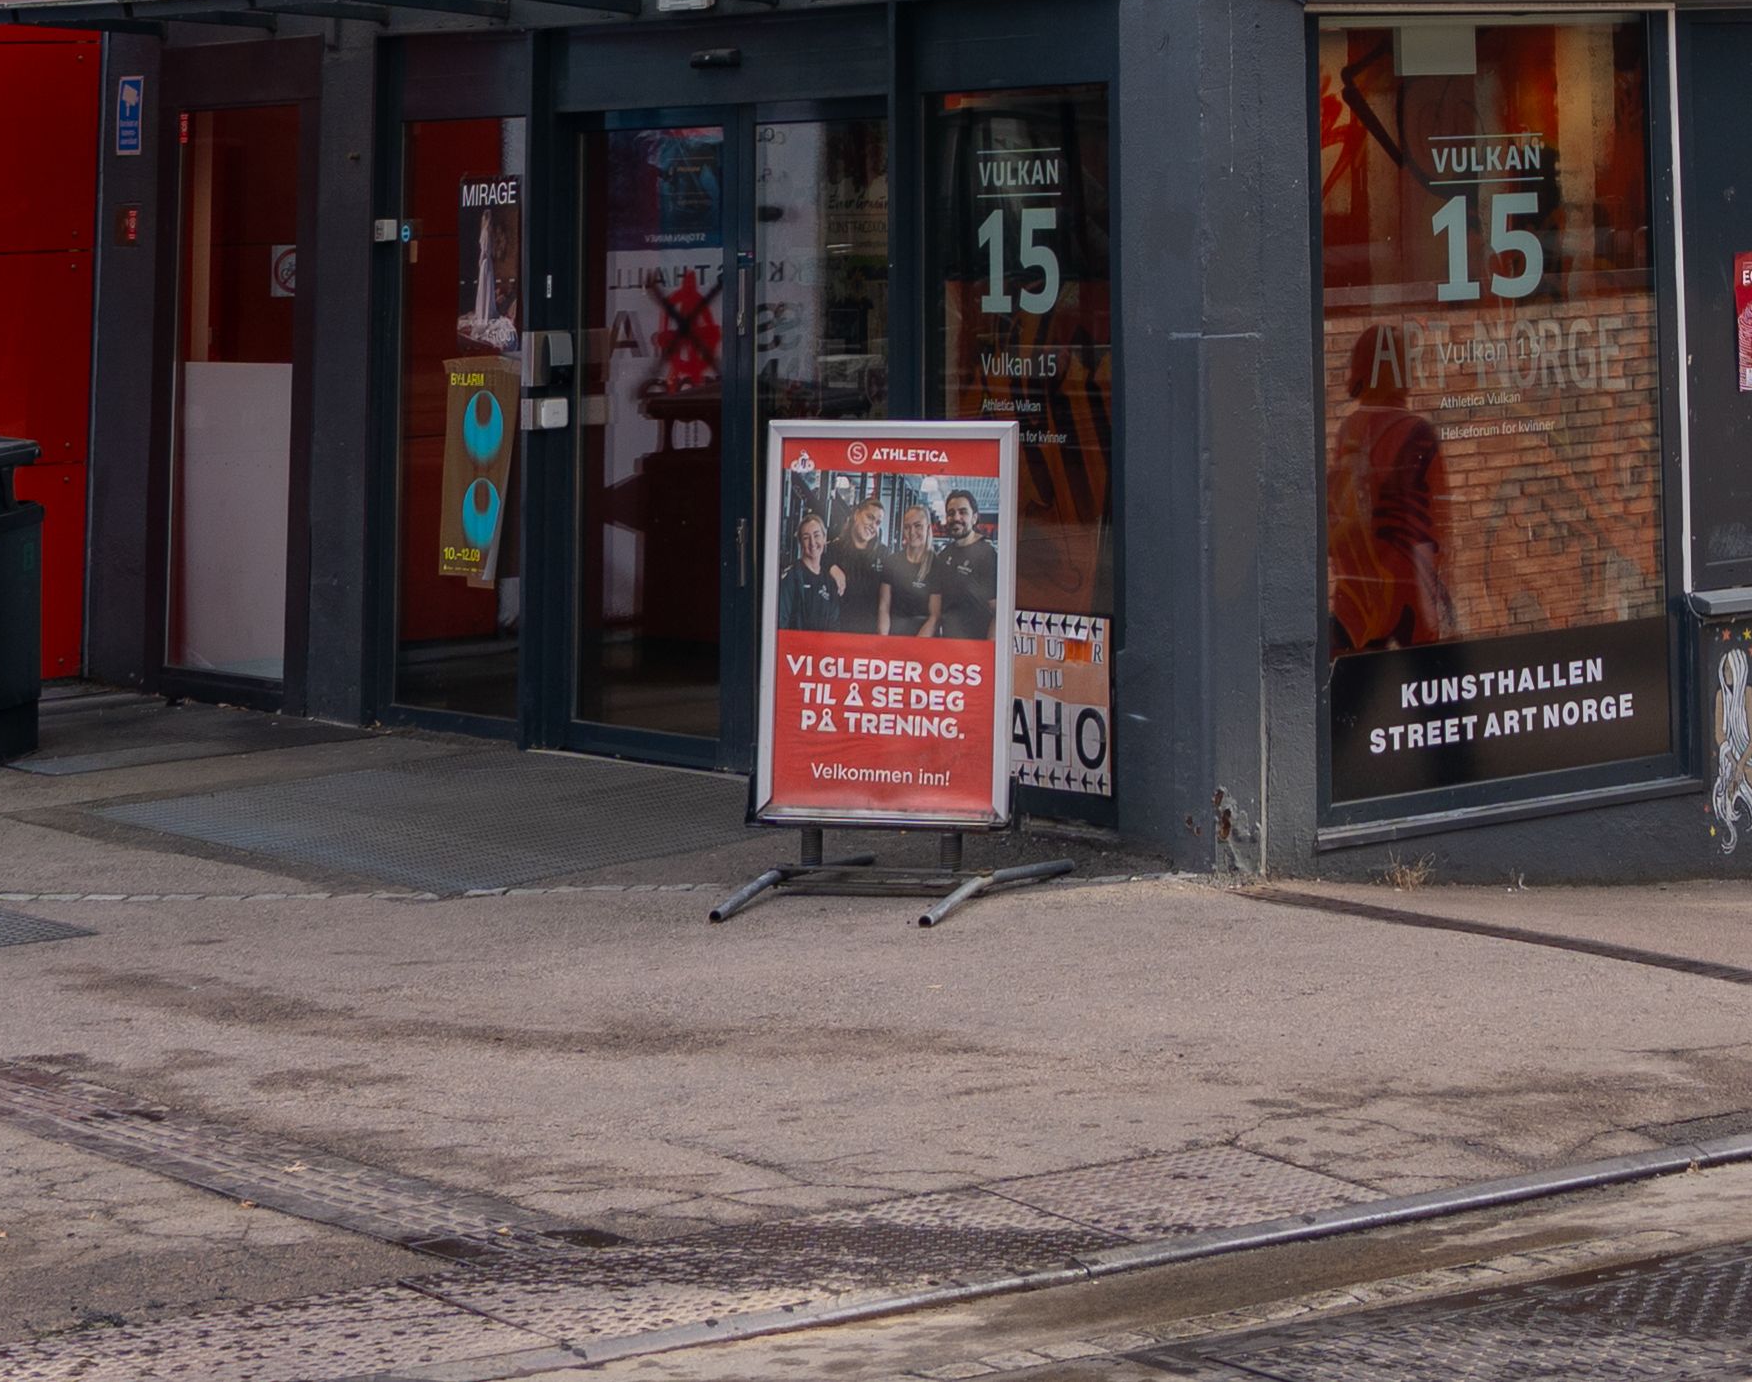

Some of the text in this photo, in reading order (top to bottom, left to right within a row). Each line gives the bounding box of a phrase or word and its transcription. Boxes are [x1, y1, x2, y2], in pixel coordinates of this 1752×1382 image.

[979, 158, 1060, 187] VULKAN
[1430, 143, 1543, 173] VULKAN
[462, 182, 517, 207] MIRAGE
[1430, 191, 1544, 301] 15
[978, 207, 1060, 315] 15
[981, 352, 1057, 377] Vulkan 15
[1437, 340, 1509, 366] Vulkan
[1474, 317, 1626, 390] NORGE
[982, 398, 1041, 413] Athletica Vulkan
[1440, 391, 1521, 410] Athletica Vulkan
[1038, 428, 1067, 444] kvinner
[1441, 419, 1555, 441] Helseforum for kvinner
[872, 447, 949, 464] ATHLETICA
[786, 654, 982, 686] VI GLEDER OSS
[1400, 658, 1604, 708] KUNSTHALLEN
[800, 682, 965, 712] TIL Å SE DEG
[801, 707, 965, 740] PÅ TRENING.
[1369, 693, 1635, 754] STREET ART NORGE
[811, 762, 951, 787] Velkommen inn!
